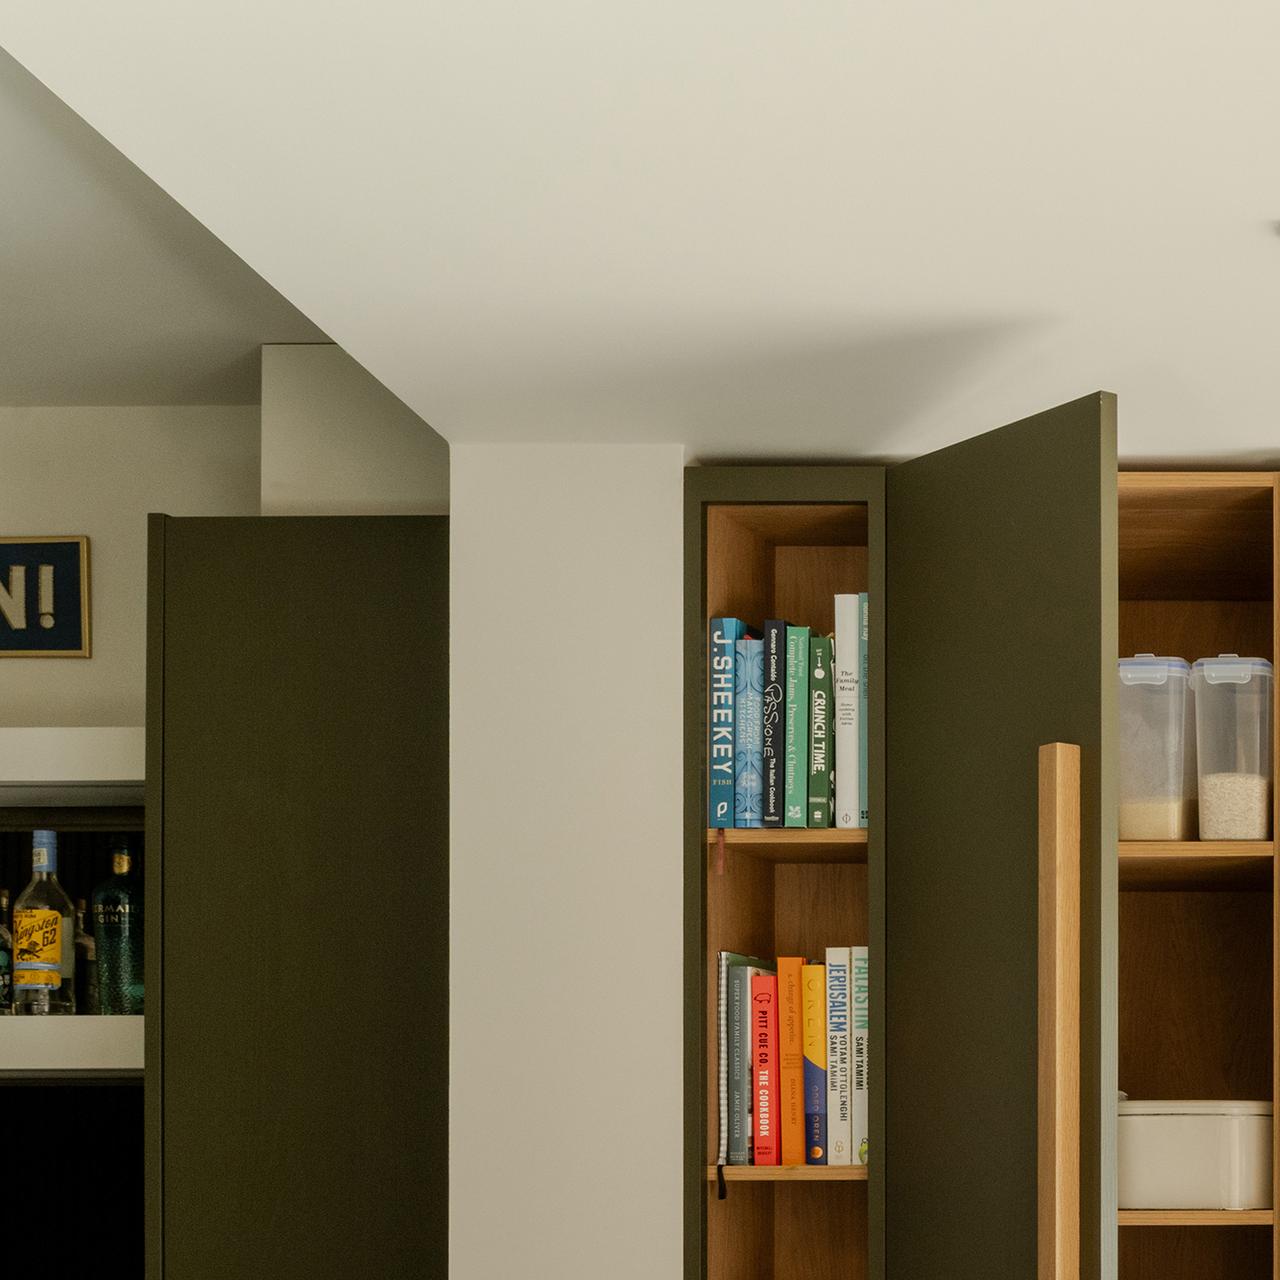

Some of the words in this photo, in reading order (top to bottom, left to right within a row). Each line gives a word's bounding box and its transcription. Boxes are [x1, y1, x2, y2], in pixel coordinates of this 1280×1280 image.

[788, 636, 797, 676] Complete
[712, 631, 732, 773] J.SHEEKEY
[788, 677, 797, 702] Jams,
[788, 704, 797, 743] Preserves
[814, 690, 825, 738] CRUNCH
[813, 741, 825, 775] TIME.
[787, 754, 796, 794] Chutneys
[98, 914, 119, 923] GIN
[42, 928, 57, 947] 62
[788, 1006, 795, 1014] of
[829, 963, 847, 1032] JERUSALEM
[759, 1010, 768, 1029] PITT
[759, 1033, 768, 1049] CUE
[839, 1035, 847, 1064] YOTAM
[856, 1036, 864, 1058] SAMI
[759, 1053, 768, 1067] CO.
[759, 1070, 768, 1086] THE
[856, 1060, 864, 1090] TAMIMI
[759, 1090, 769, 1136] COOKBOOK
